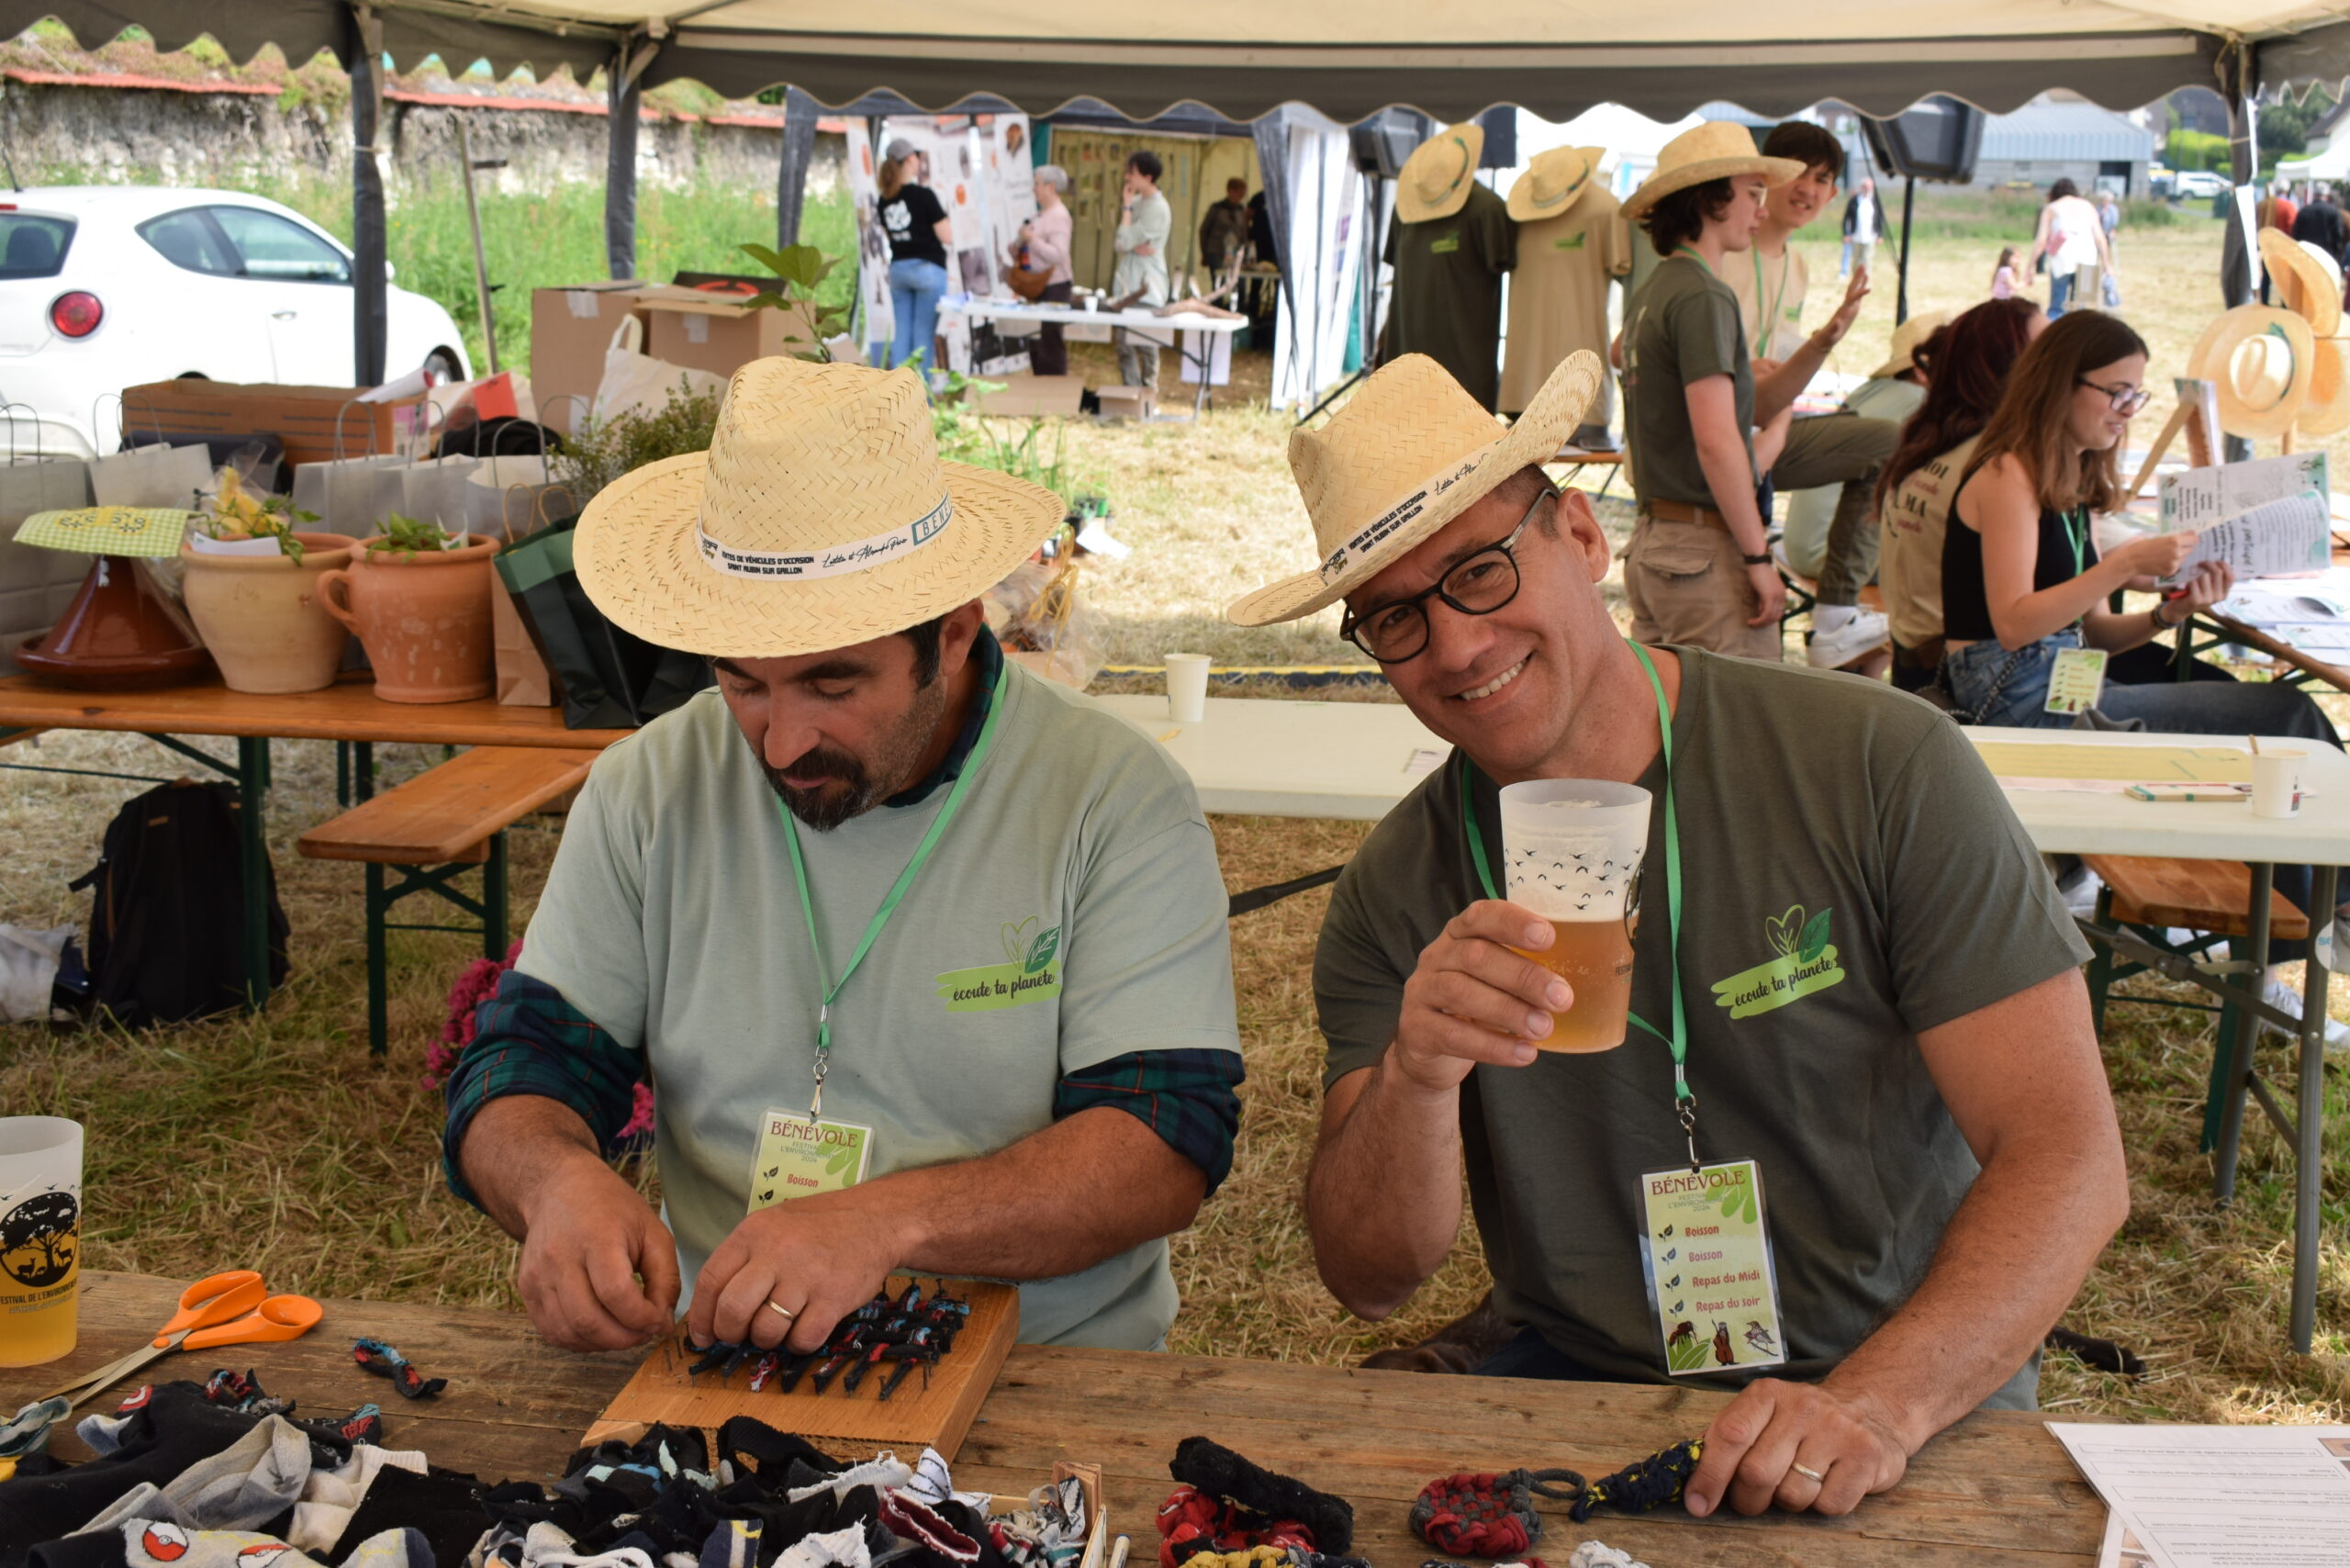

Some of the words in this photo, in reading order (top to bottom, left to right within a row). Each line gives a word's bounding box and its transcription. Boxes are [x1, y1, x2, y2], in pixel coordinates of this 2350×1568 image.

[1389, 520, 1402, 532] SUR
[1363, 530, 1371, 539] DE
[745, 554, 776, 565] VÉHICULES
[778, 556, 814, 565] D'OCCASION
[953, 980, 992, 1002] écoute
[993, 979, 1008, 995] ta
[1734, 980, 1770, 1006] écoute
[1771, 976, 1786, 992] ta
[770, 1120, 859, 1148] BÉNÉVOLE
[787, 1173, 820, 1188] Boisson
[1651, 1170, 1747, 1196] BÉNÉVOLE
[1684, 1224, 1720, 1238] Boisson
[1688, 1249, 1723, 1263] Boisson
[1692, 1275, 1722, 1290] Repas
[1723, 1272, 1736, 1285] du
[1738, 1269, 1761, 1282] Midi
[28, 1293, 37, 1302] DE
[1695, 1300, 1725, 1314] Repas
[1726, 1297, 1740, 1309] du
[1741, 1296, 1761, 1309] soir
